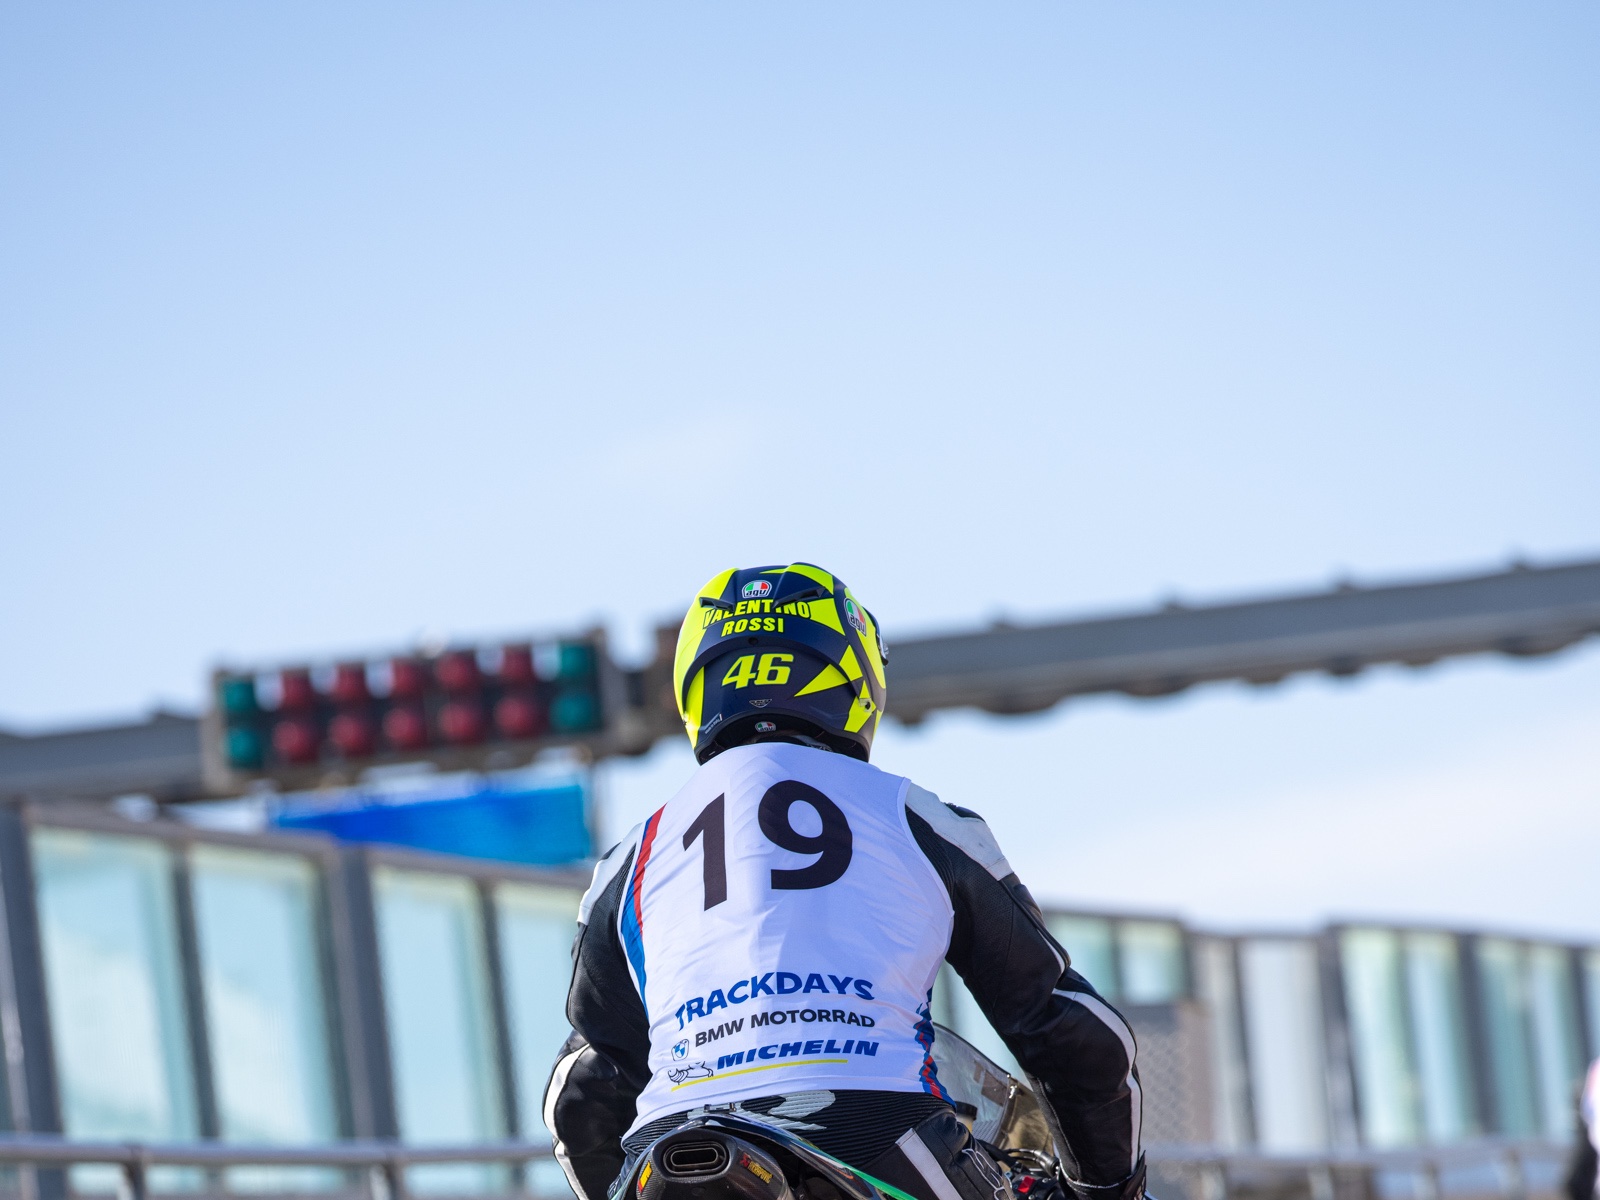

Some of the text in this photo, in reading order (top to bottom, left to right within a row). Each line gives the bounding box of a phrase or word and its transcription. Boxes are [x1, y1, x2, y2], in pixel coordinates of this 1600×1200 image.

[721, 617, 784, 637] ROSSI
[721, 653, 795, 689] 46
[682, 779, 853, 912] 19
[675, 971, 875, 1031] TRACKDAYS
[695, 1008, 876, 1048] BMW MOTORRAD
[716, 1039, 880, 1070] MICHELIN
